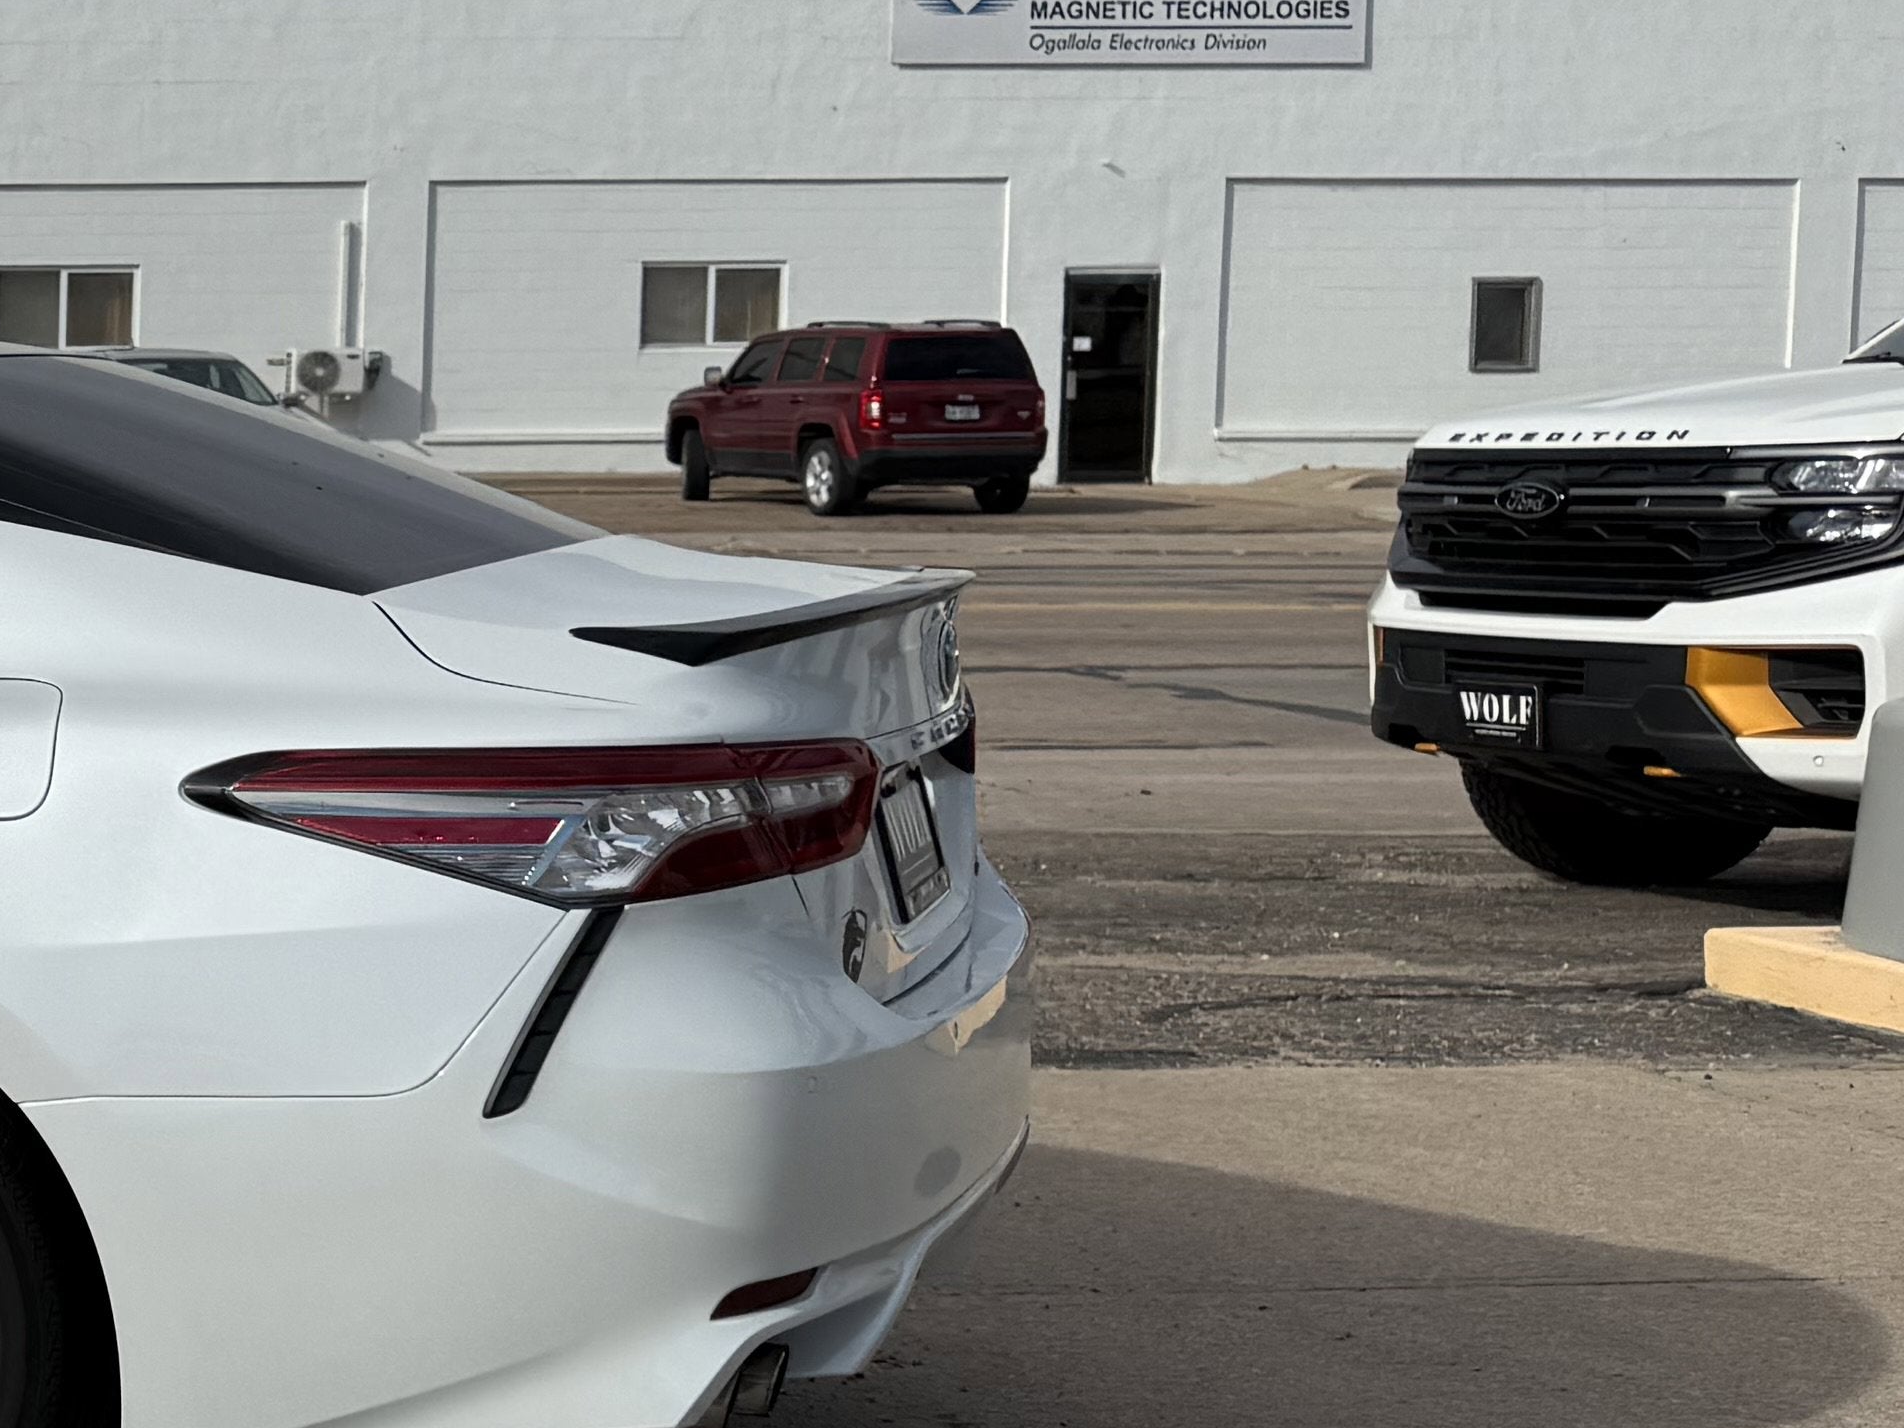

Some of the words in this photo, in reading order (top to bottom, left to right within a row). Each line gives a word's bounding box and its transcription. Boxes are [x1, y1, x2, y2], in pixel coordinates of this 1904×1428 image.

[1030, 0, 1154, 21] MAGNETIC
[1162, 0, 1351, 21] TECHNOLOGIES
[1029, 33, 1102, 56] Ogallala
[1109, 33, 1196, 52] Electronics
[1204, 33, 1267, 52] Division
[1448, 429, 1690, 443] EXPEDITION
[1505, 487, 1546, 512] Ford
[1459, 690, 1533, 725] WOLF
